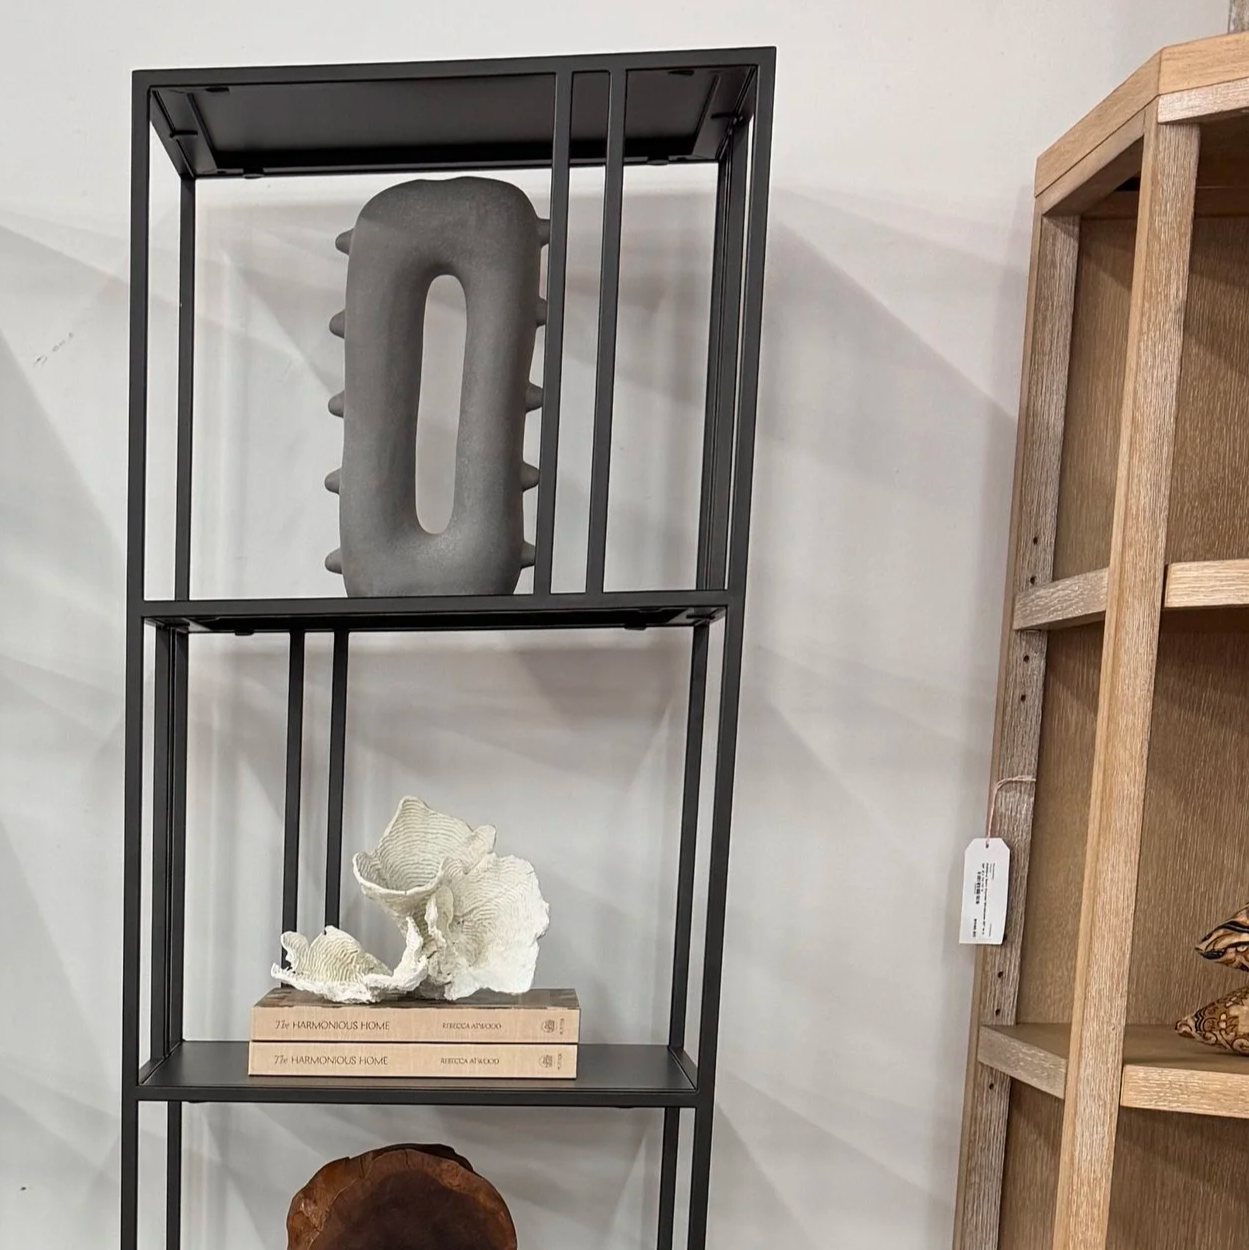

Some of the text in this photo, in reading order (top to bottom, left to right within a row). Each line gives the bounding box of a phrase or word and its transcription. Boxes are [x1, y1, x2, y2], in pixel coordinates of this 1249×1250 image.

[275, 1020, 390, 1030] The HARMONIOUS HOME
[291, 1055, 357, 1065] HARMONIOUS
[359, 1056, 388, 1065] HOME
